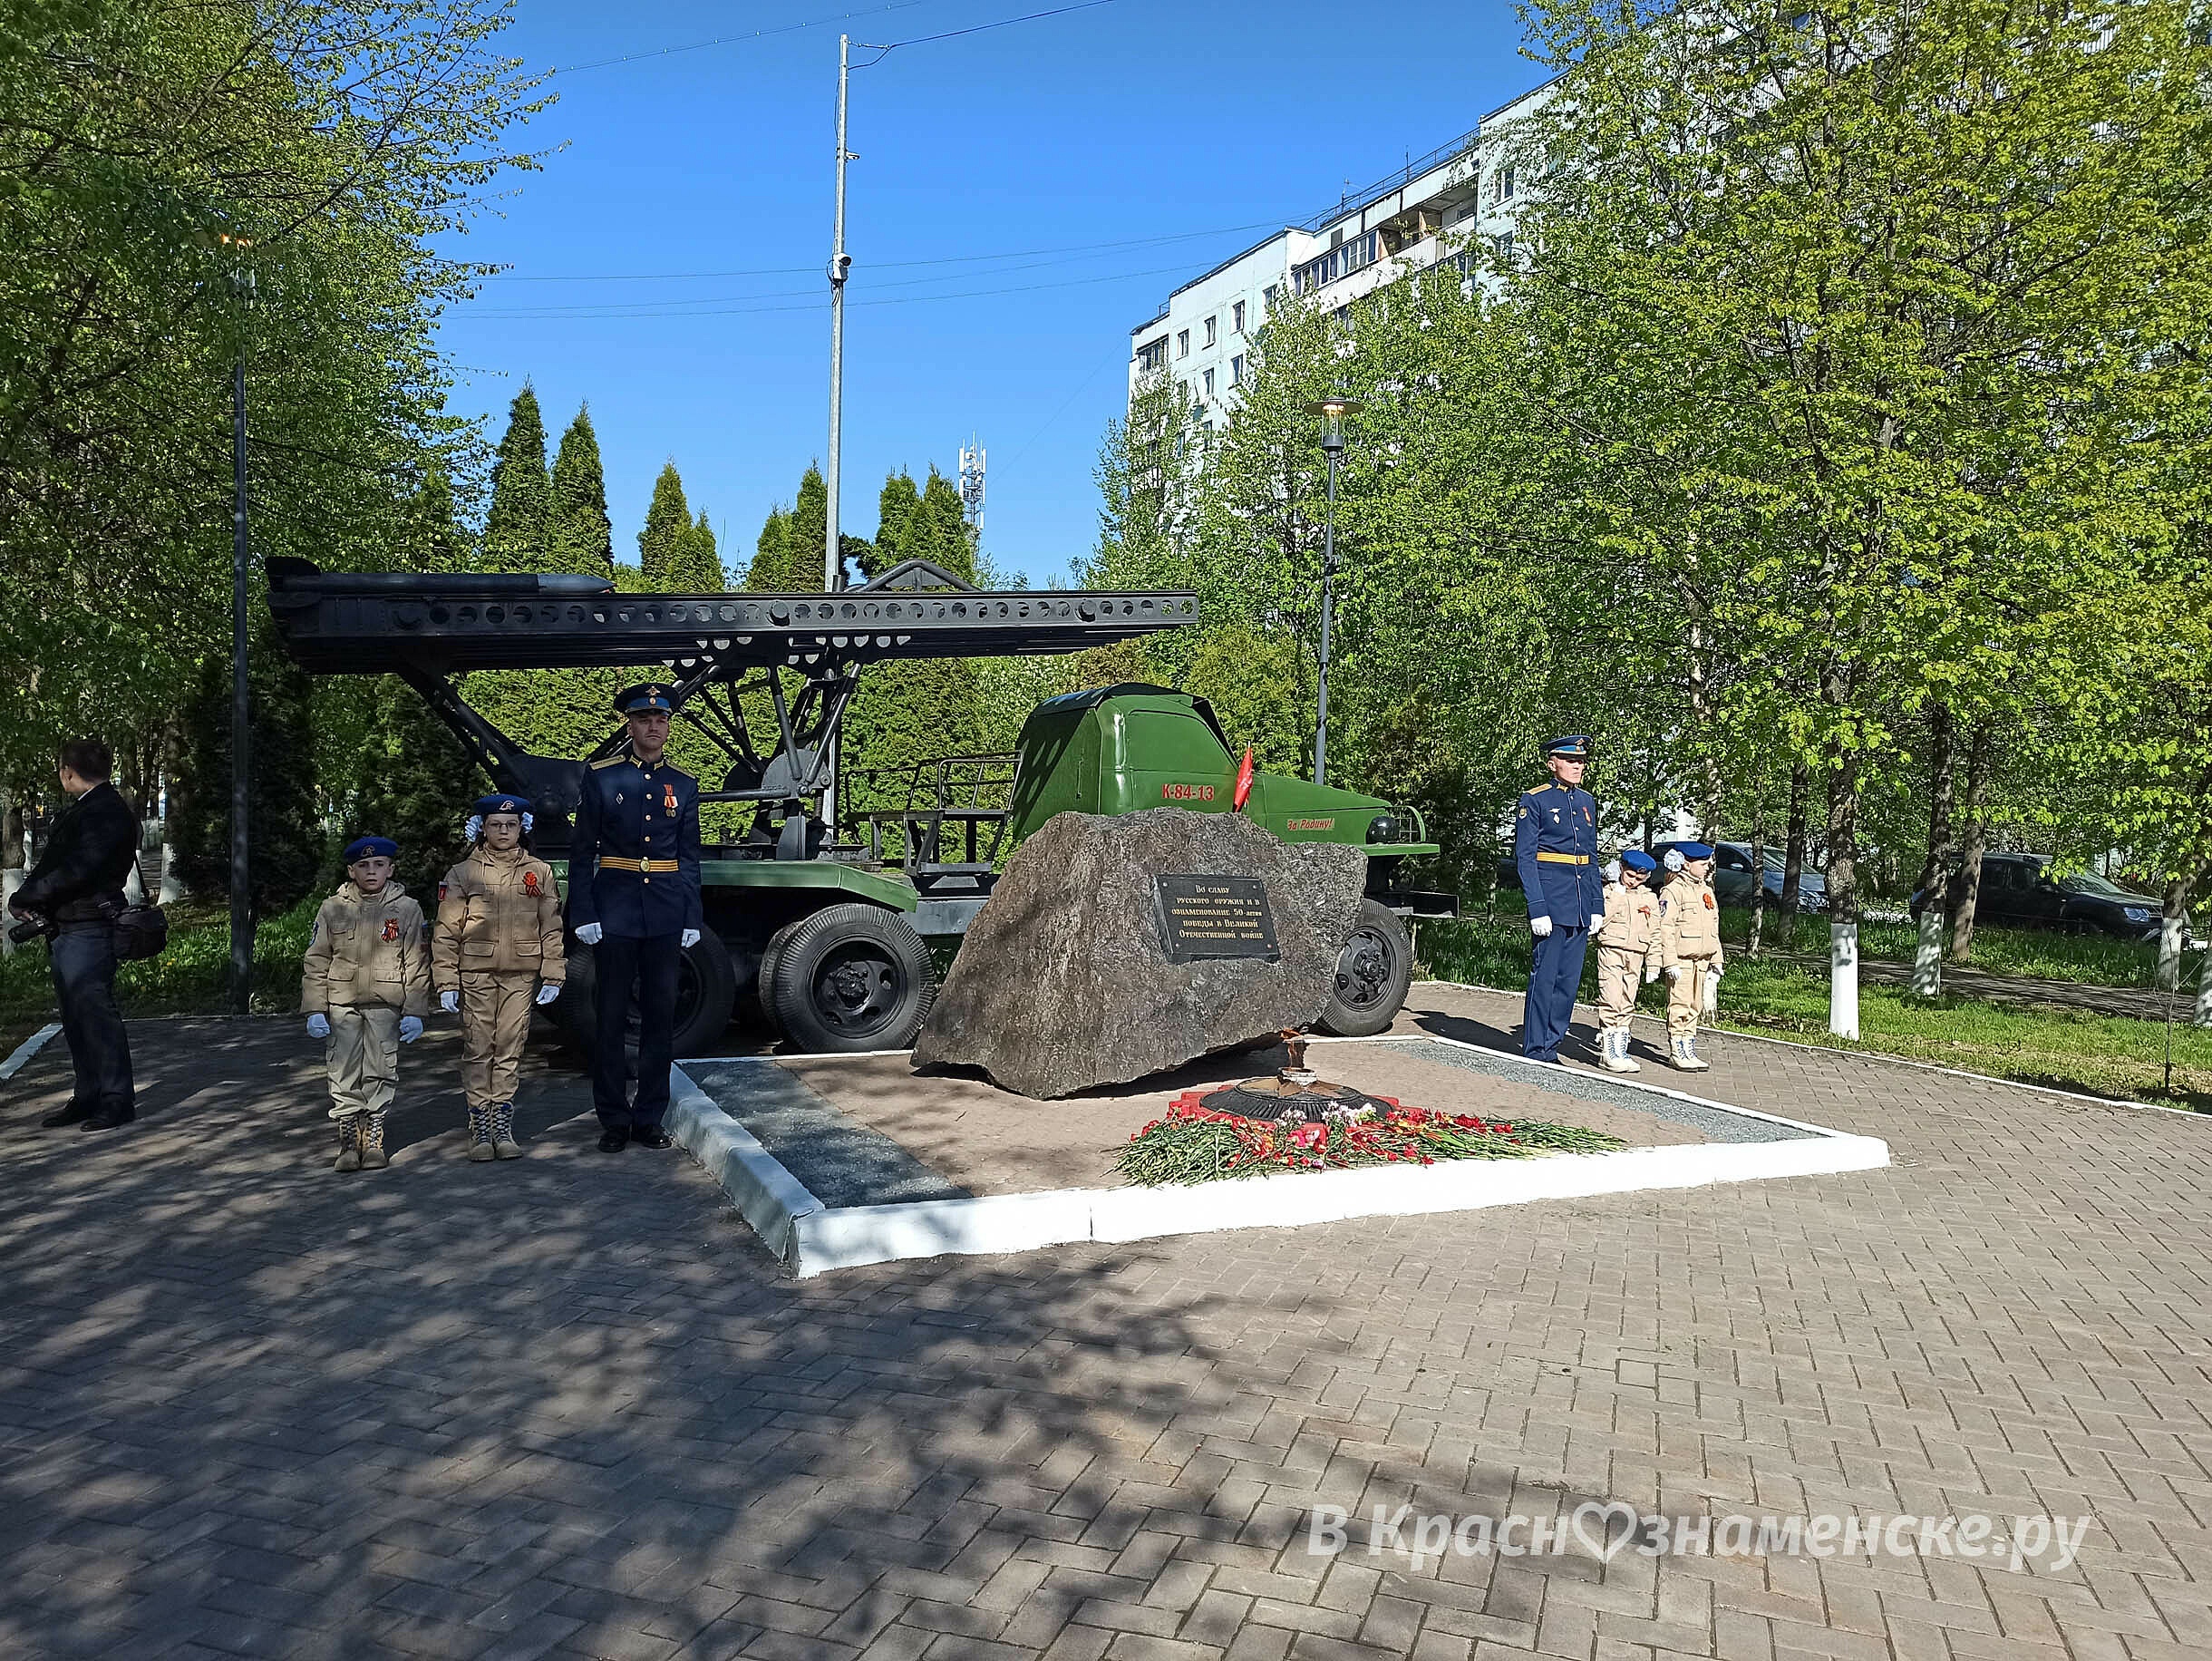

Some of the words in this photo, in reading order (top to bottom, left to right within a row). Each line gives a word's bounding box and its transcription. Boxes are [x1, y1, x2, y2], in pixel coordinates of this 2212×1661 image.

[1161, 783, 1215, 801] К-84-13
[1287, 819, 1298, 831] За
[1300, 818, 1334, 831] Родину!
[1195, 884, 1206, 893] Во
